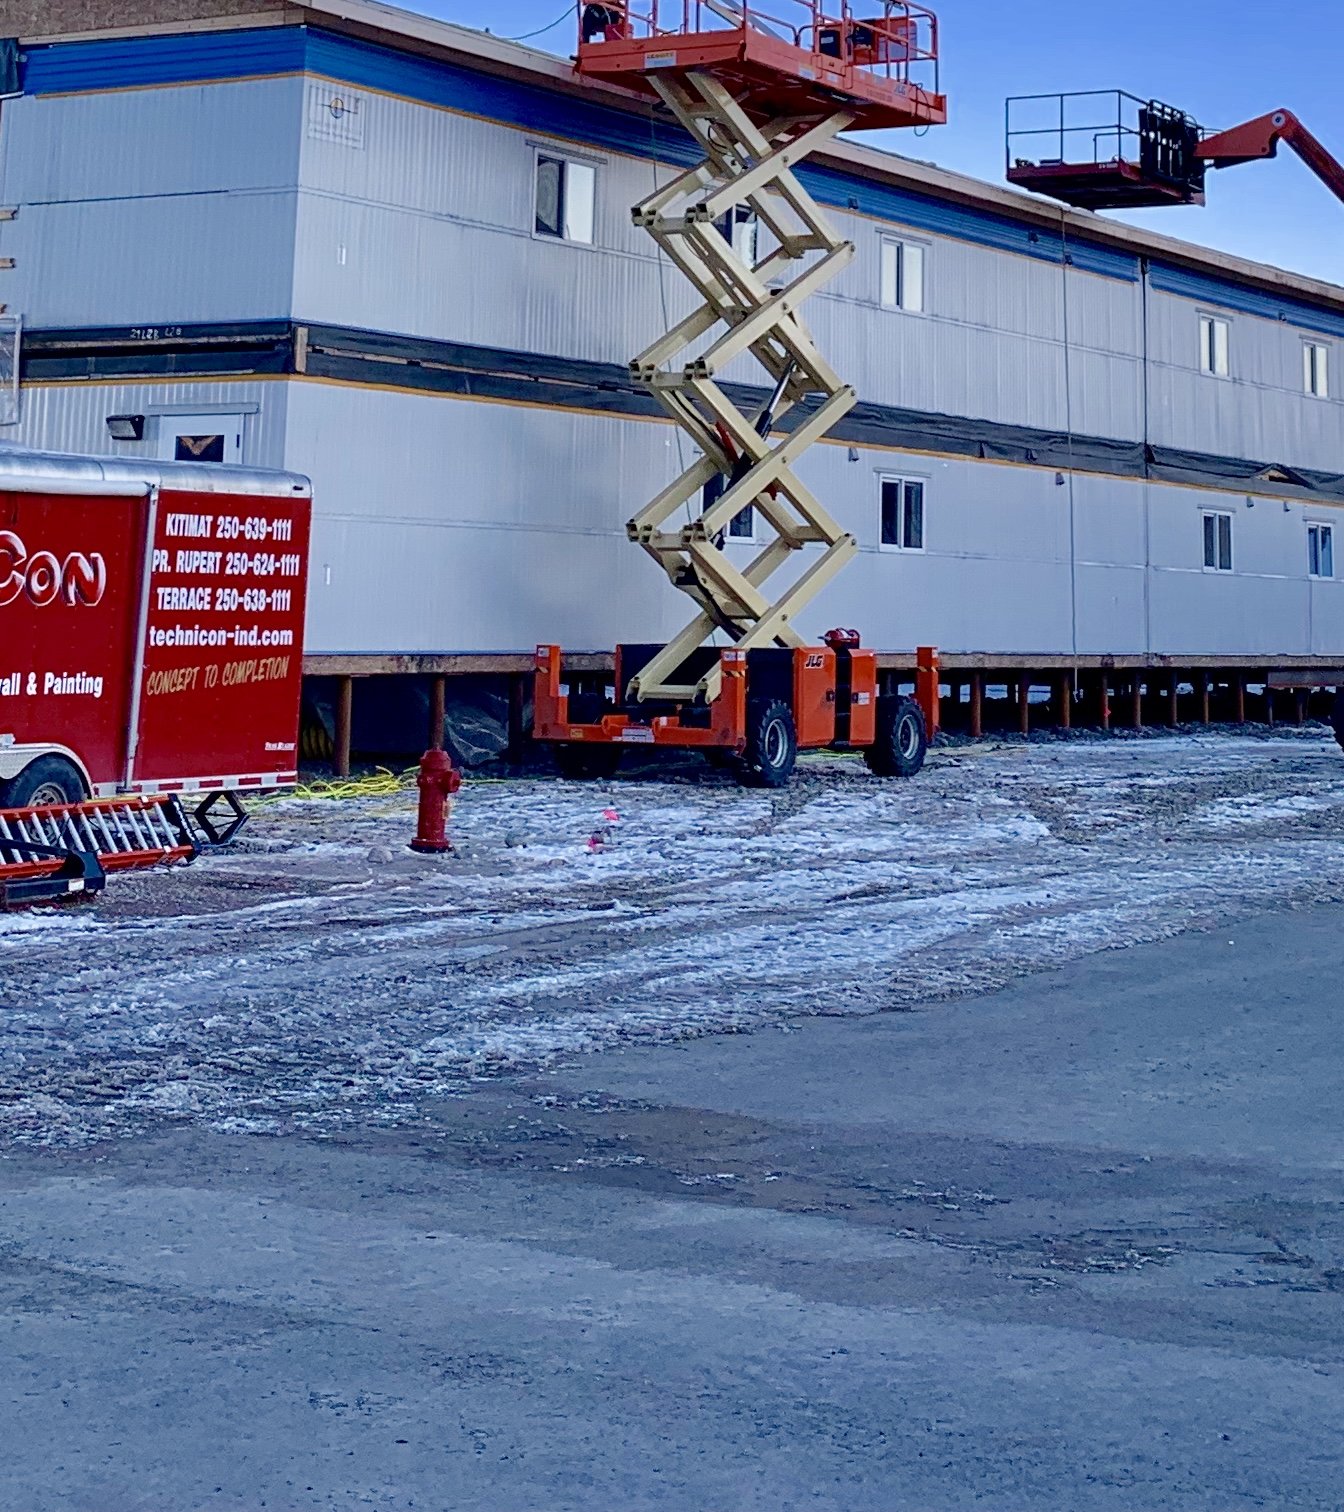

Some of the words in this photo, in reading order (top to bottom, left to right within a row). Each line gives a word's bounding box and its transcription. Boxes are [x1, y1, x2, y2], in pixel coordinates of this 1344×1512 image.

[166, 513, 213, 538] KITIMAT
[216, 516, 292, 541] 250-639-1111
[152, 549, 171, 573] PR.
[176, 550, 223, 574] RUPERT
[225, 552, 300, 576] 250-624-1111
[157, 587, 212, 610] TERRACE
[215, 589, 291, 612] 250-638-1111
[150, 625, 293, 647] technicon-ind.com
[805, 655, 824, 668] JLG
[26, 672, 38, 695] &
[44, 671, 103, 698] Painting
[146, 666, 200, 696] CONCEPT
[205, 664, 219, 688] TO
[222, 655, 290, 687] COMPLETION
